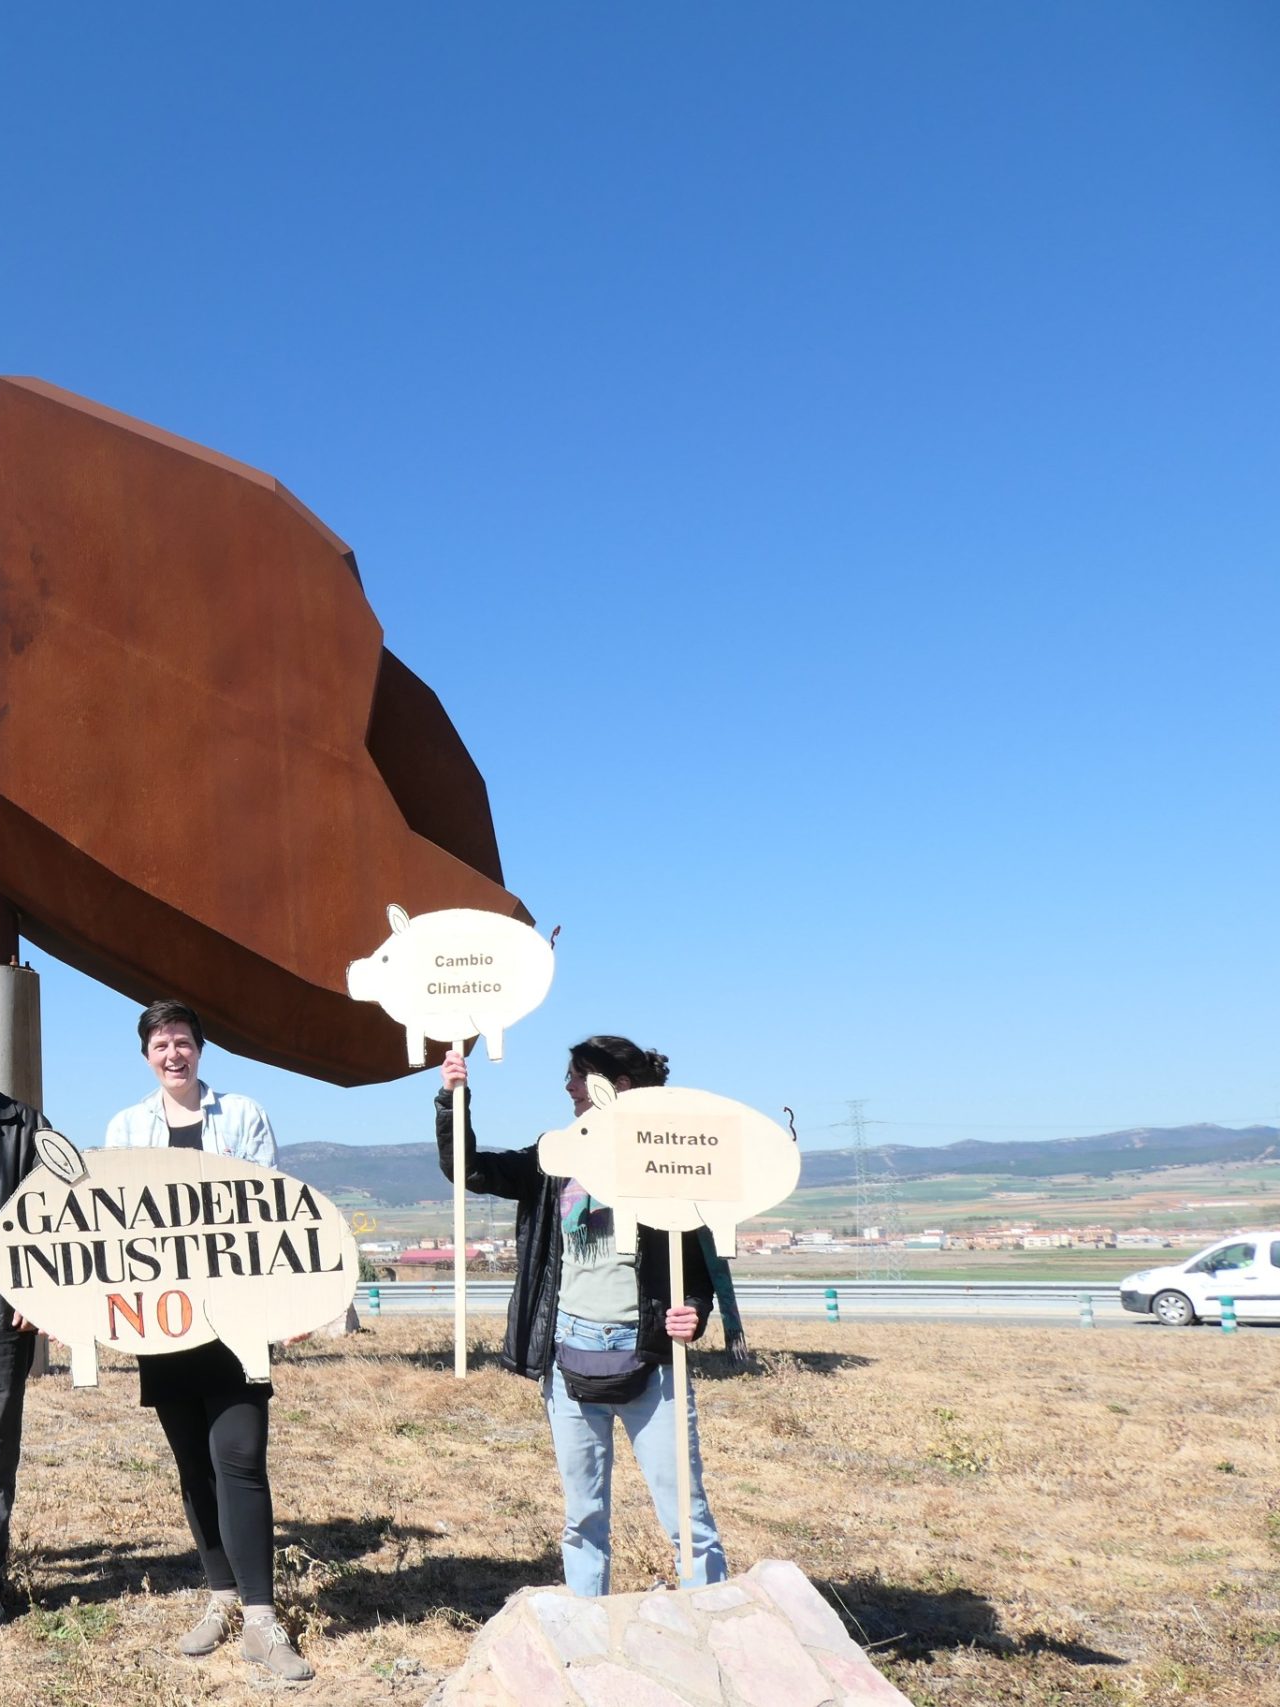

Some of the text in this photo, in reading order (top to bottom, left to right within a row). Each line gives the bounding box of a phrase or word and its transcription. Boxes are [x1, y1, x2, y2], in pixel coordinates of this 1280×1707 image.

[434, 953, 494, 968] Cambio
[426, 980, 503, 995] Climático
[637, 1130, 719, 1146] Maltrato
[645, 1160, 713, 1176] Animal
[15, 1177, 323, 1235] GANADERIA
[6, 1226, 345, 1290] INDUSTRIAL
[105, 1289, 194, 1341] NO
